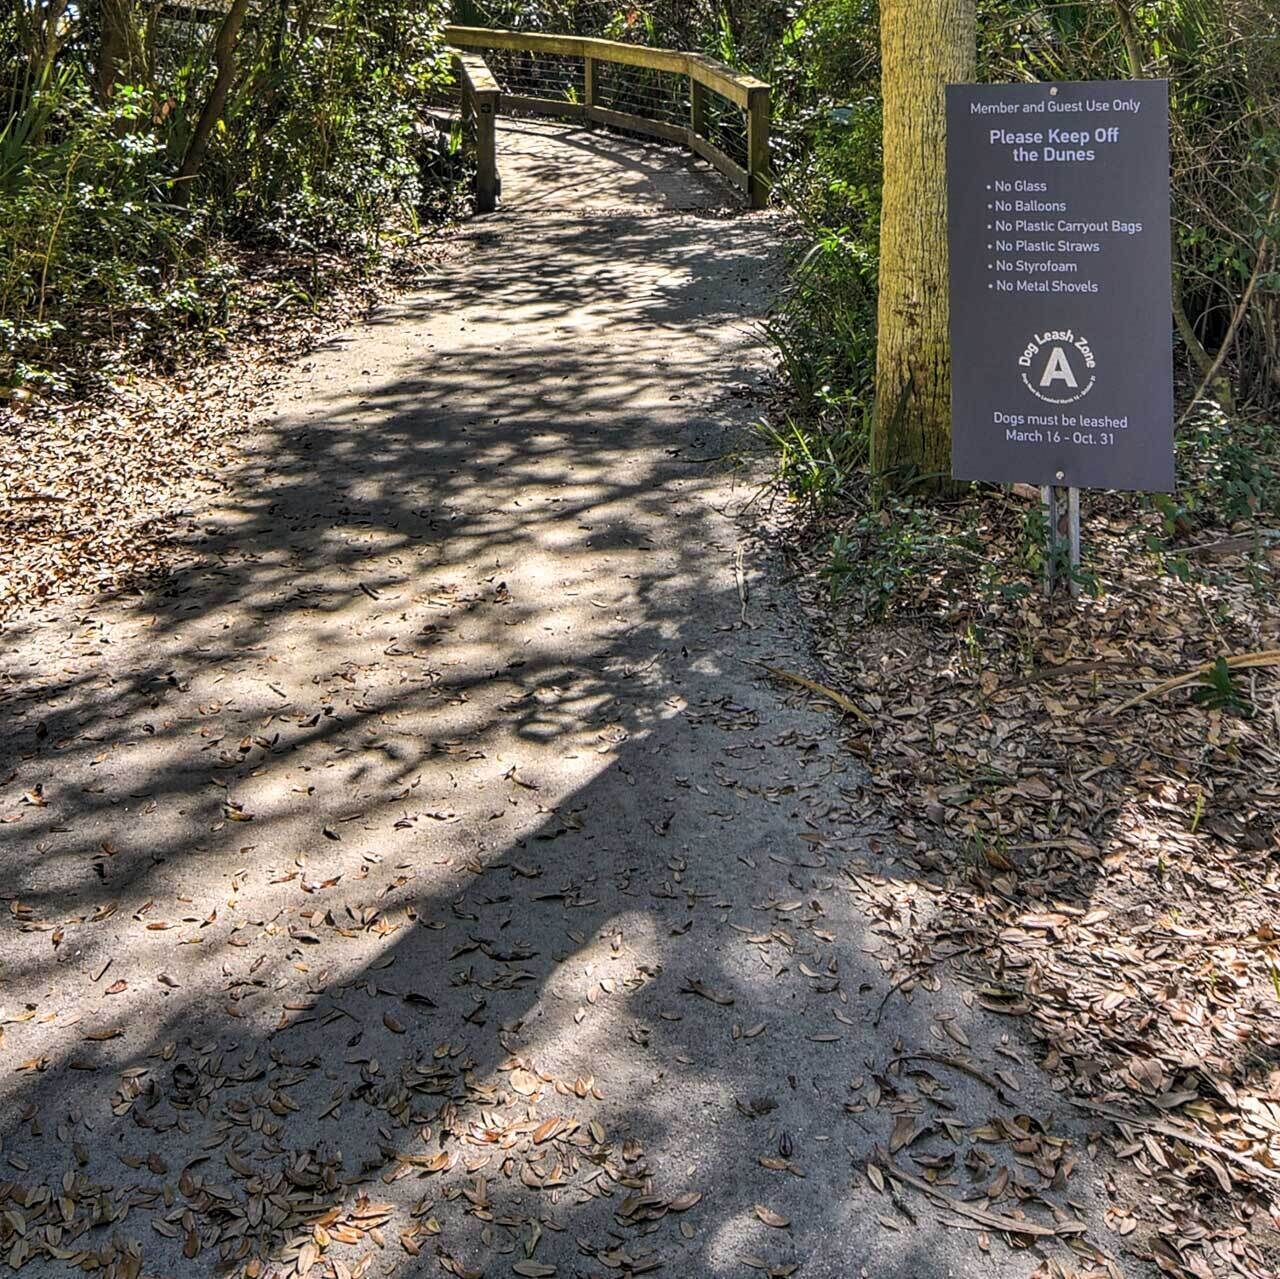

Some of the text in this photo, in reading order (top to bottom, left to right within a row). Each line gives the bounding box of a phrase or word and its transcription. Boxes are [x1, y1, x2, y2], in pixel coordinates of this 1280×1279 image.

[970, 99, 1140, 114] Member and Guest Use Only
[990, 127, 1119, 146] Please Keep Off
[1013, 147, 1095, 161] the Dunes
[995, 180, 1047, 192] No Glass
[995, 200, 1066, 211] No Balloons
[995, 220, 1142, 234] No Plastic Carryout Bags
[996, 240, 1100, 252] No Plastic Straws
[996, 260, 1077, 274] No Styrofoam
[997, 280, 1098, 292] No Metal Shovels
[1019, 329, 1096, 368] Dog Leash Zone
[1040, 347, 1078, 387] A
[994, 412, 1127, 428] Dogs must be leashed
[1006, 429, 1042, 442] March
[1047, 431, 1061, 443] 16
[1073, 432, 1096, 444] Oct.
[1100, 433, 1114, 445] 31
